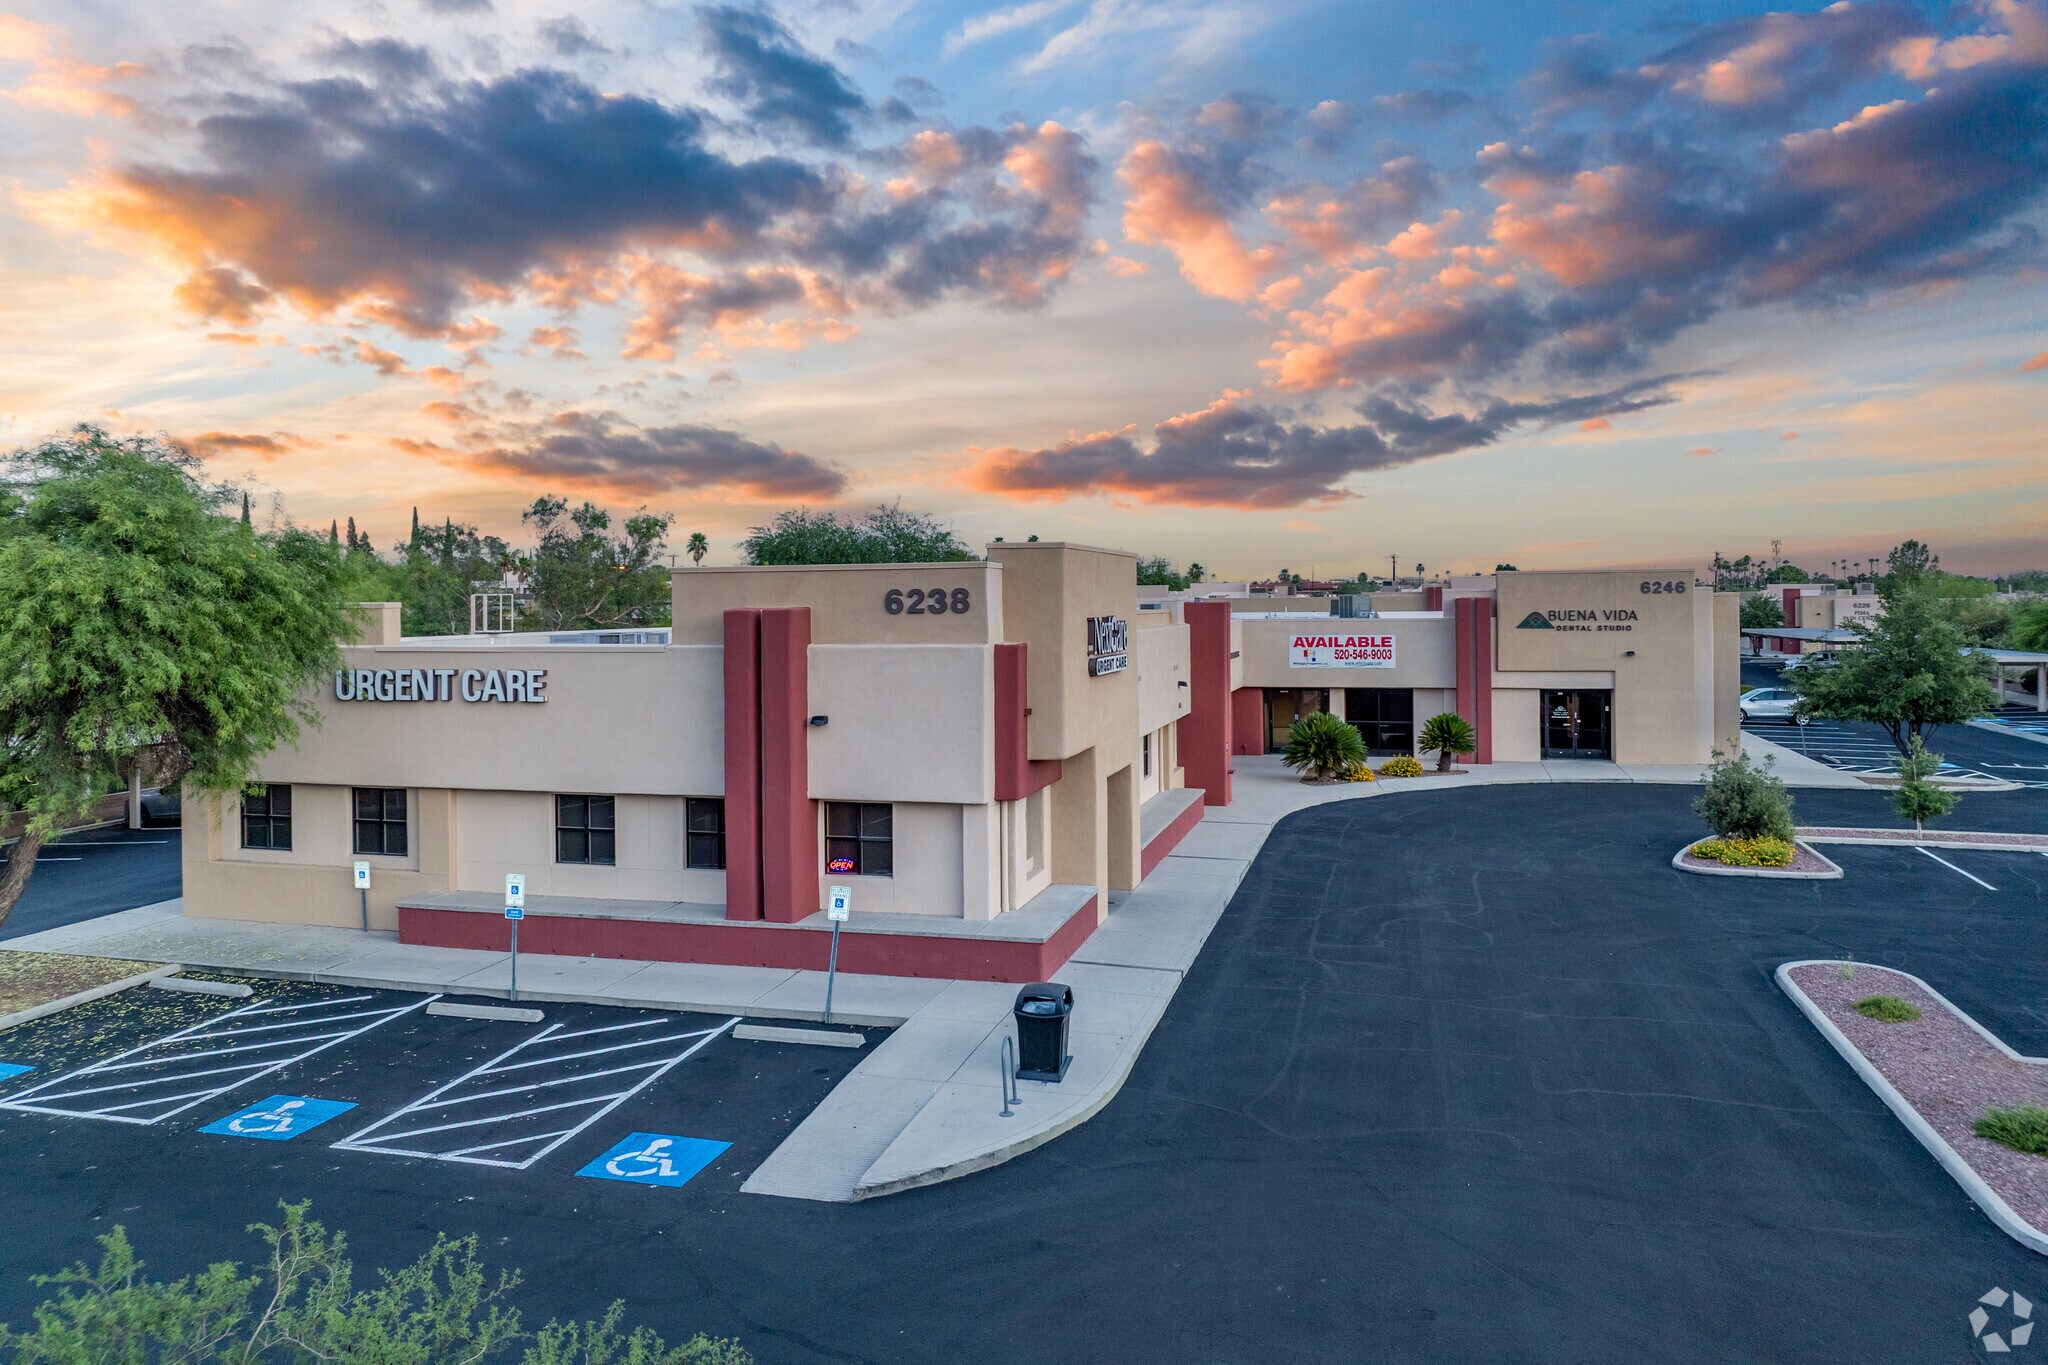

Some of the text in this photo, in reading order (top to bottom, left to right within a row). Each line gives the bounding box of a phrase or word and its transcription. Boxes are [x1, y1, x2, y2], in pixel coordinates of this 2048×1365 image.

[1640, 581, 1686, 594] 6246
[884, 588, 970, 615] 6238
[1548, 610, 1638, 621] BUENA VIDA
[1293, 636, 1392, 648] AVAILABLE
[1334, 649, 1392, 660] 520-546-9003
[1097, 655, 1127, 674] URGENT CARE
[335, 668, 547, 703] URGENT CARE
[830, 861, 854, 869] OPEN
